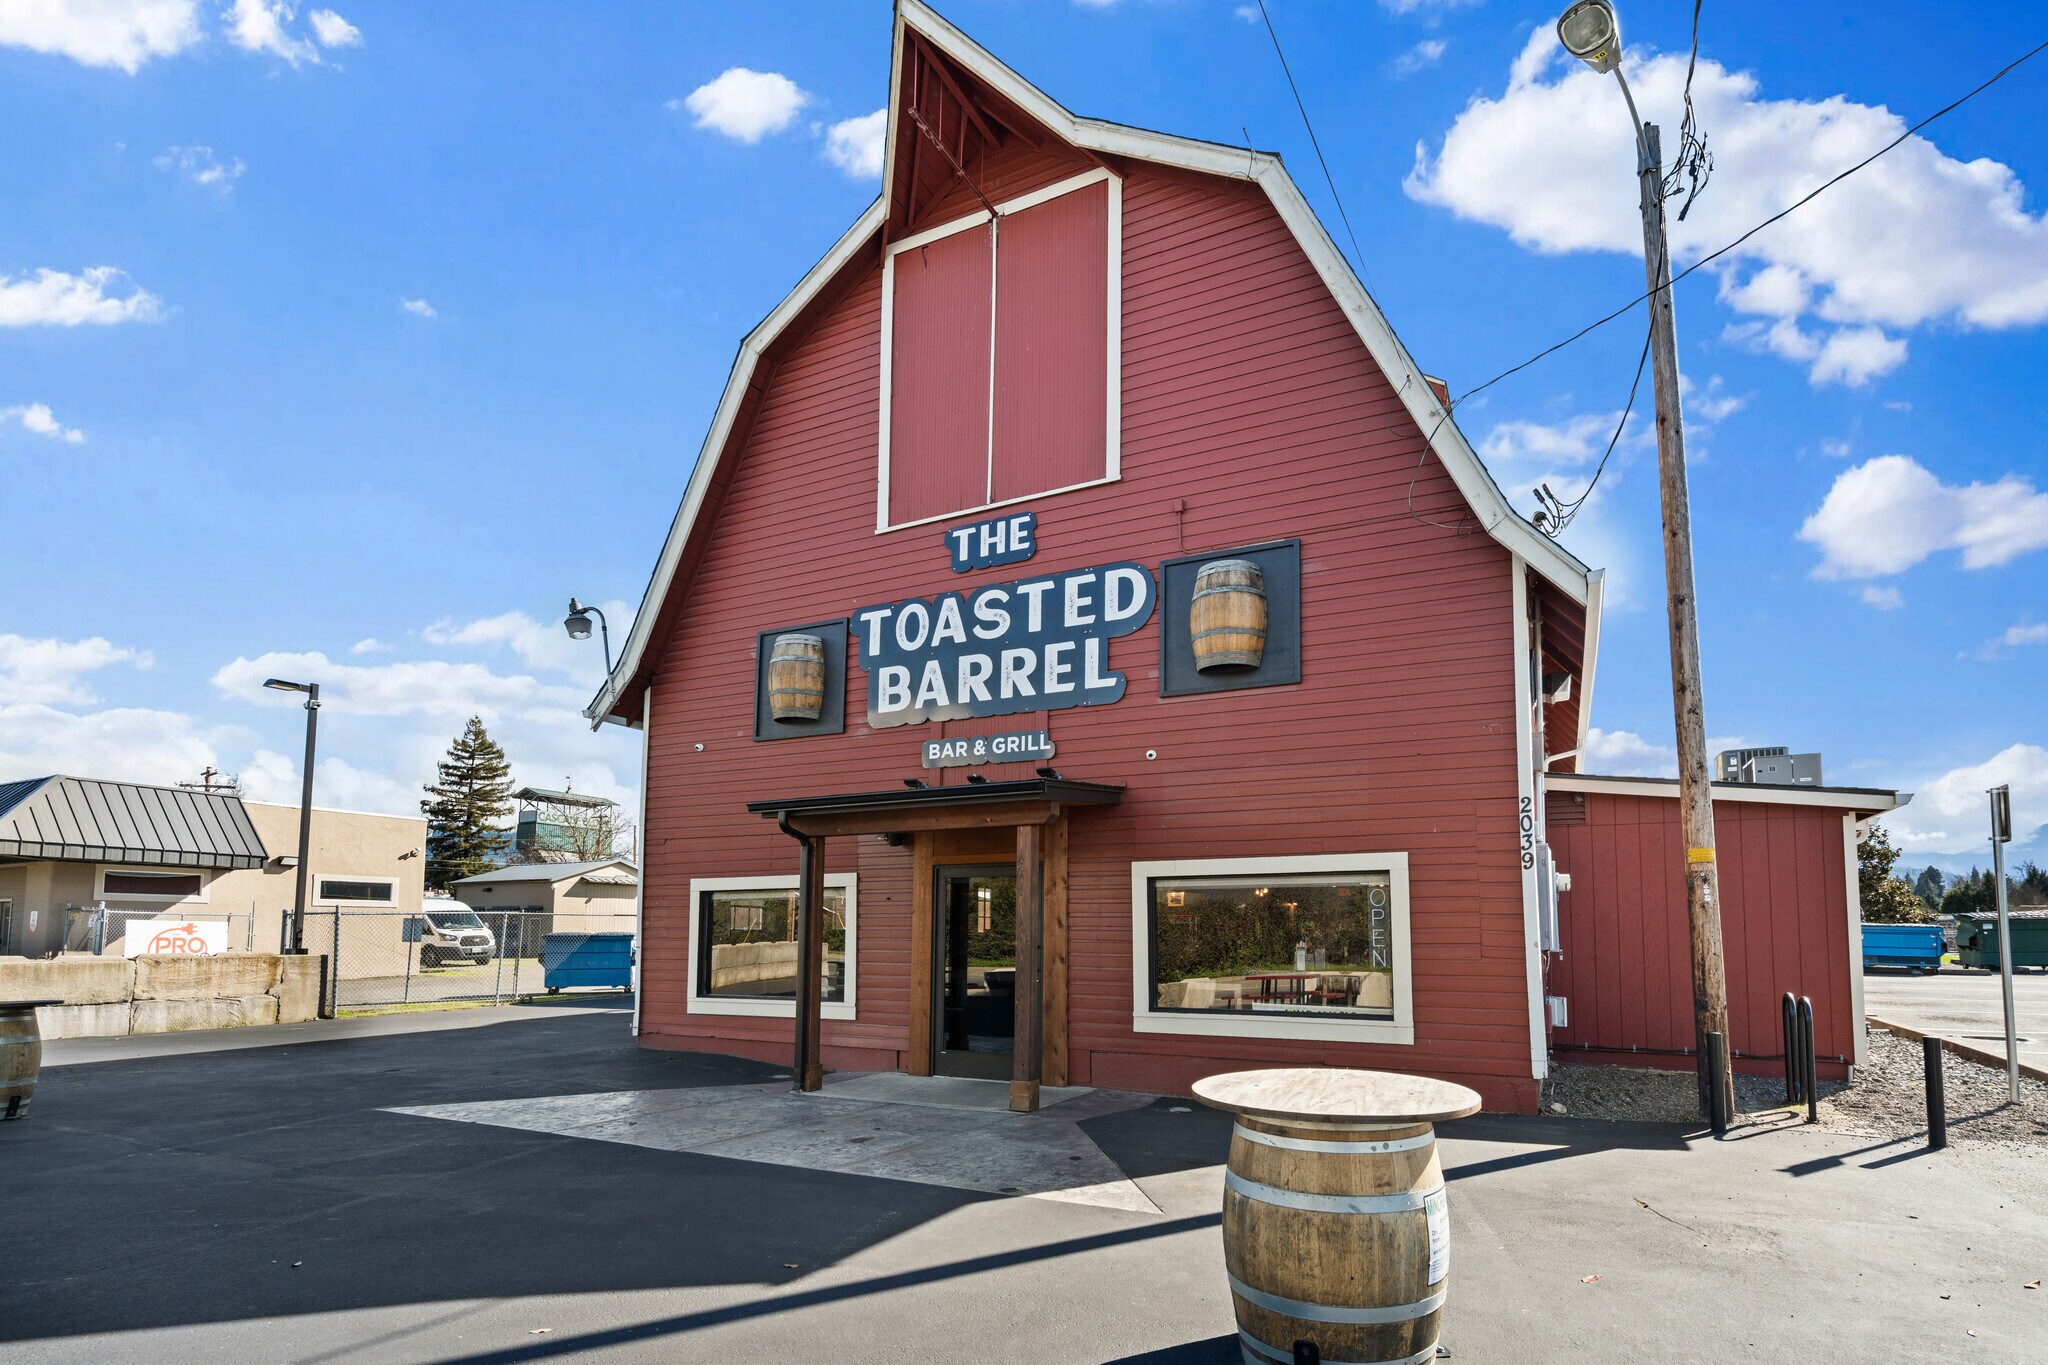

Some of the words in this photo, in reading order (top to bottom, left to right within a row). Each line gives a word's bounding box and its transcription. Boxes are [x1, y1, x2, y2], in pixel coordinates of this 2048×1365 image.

[952, 515, 1031, 562] THE
[859, 567, 1148, 657] TOASTED
[877, 637, 1118, 714] BARREL
[928, 741, 968, 760] BAR
[973, 739, 986, 756] &
[992, 733, 1052, 754] GRILL
[1520, 796, 1535, 870] 2039
[155, 936, 206, 954] PRO
[1369, 888, 1387, 967] OPEN
